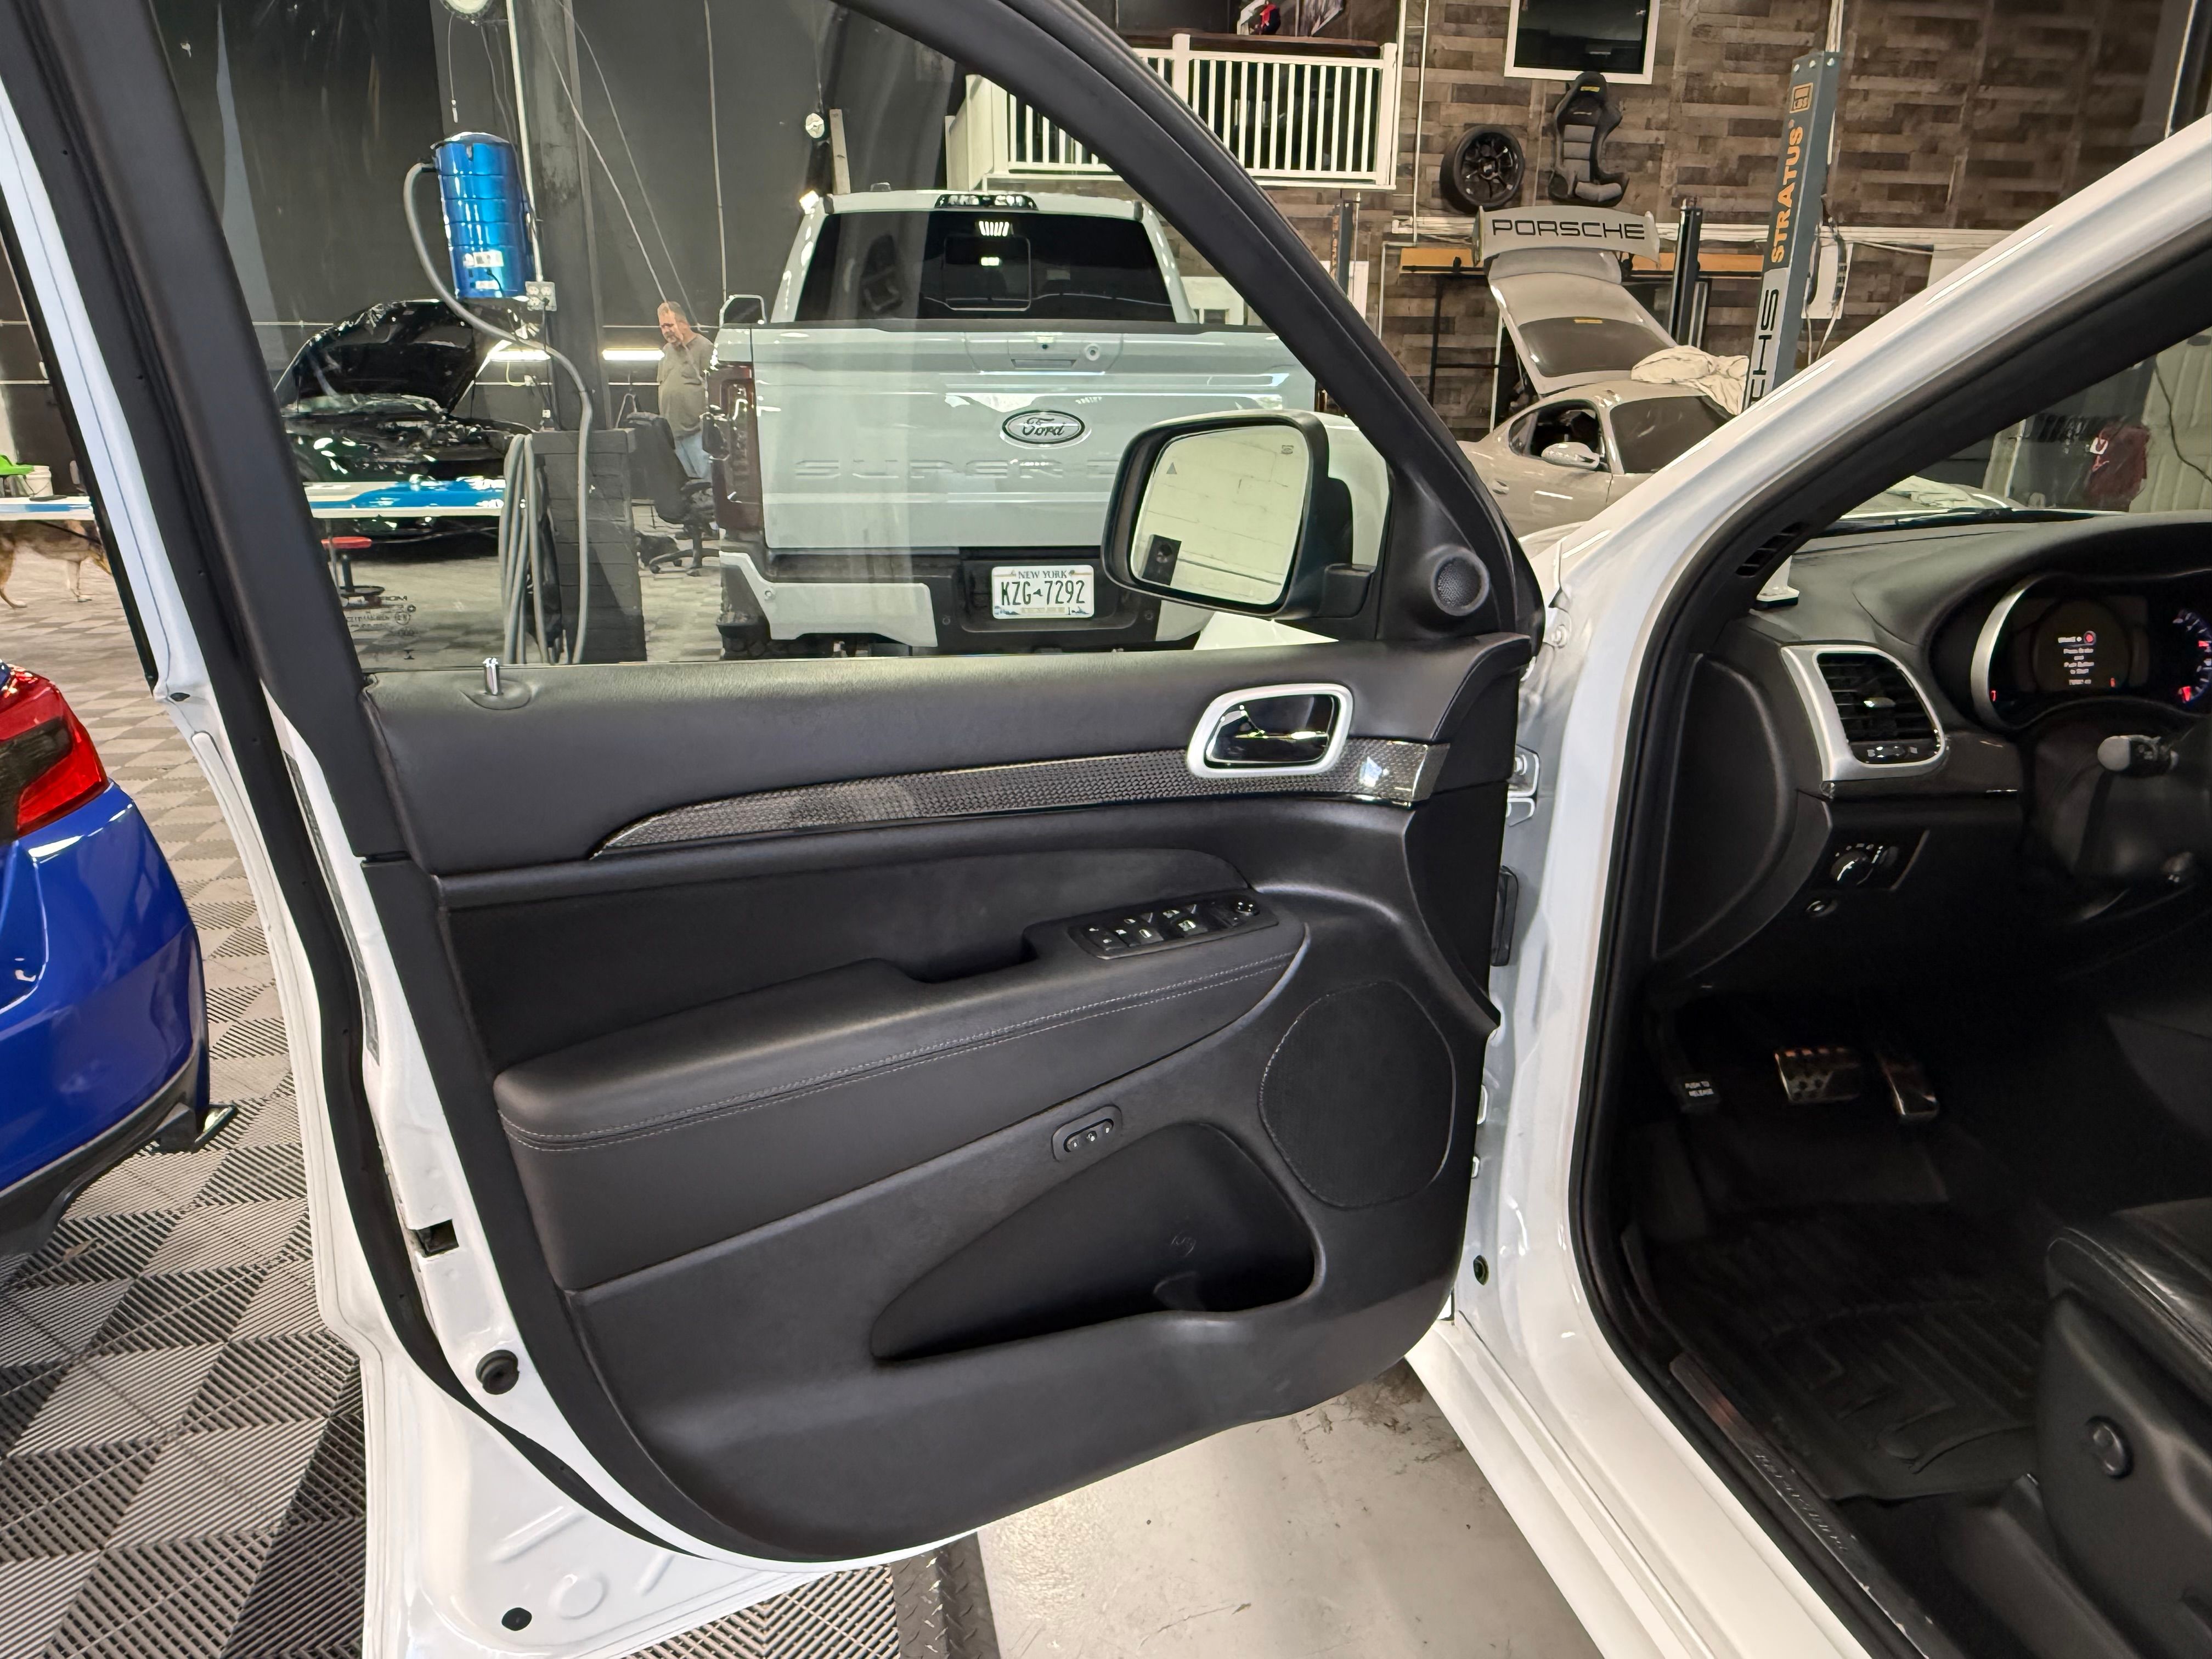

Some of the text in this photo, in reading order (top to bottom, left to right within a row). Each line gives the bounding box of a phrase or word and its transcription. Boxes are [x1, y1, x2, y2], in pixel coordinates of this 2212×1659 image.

[1771, 126, 1803, 263] STRATUS
[1492, 219, 1645, 240] PORSCHE
[1022, 417, 1065, 436] Ford
[1018, 569, 1068, 579] NEW YORK
[1001, 580, 1085, 606] KZG 7292
